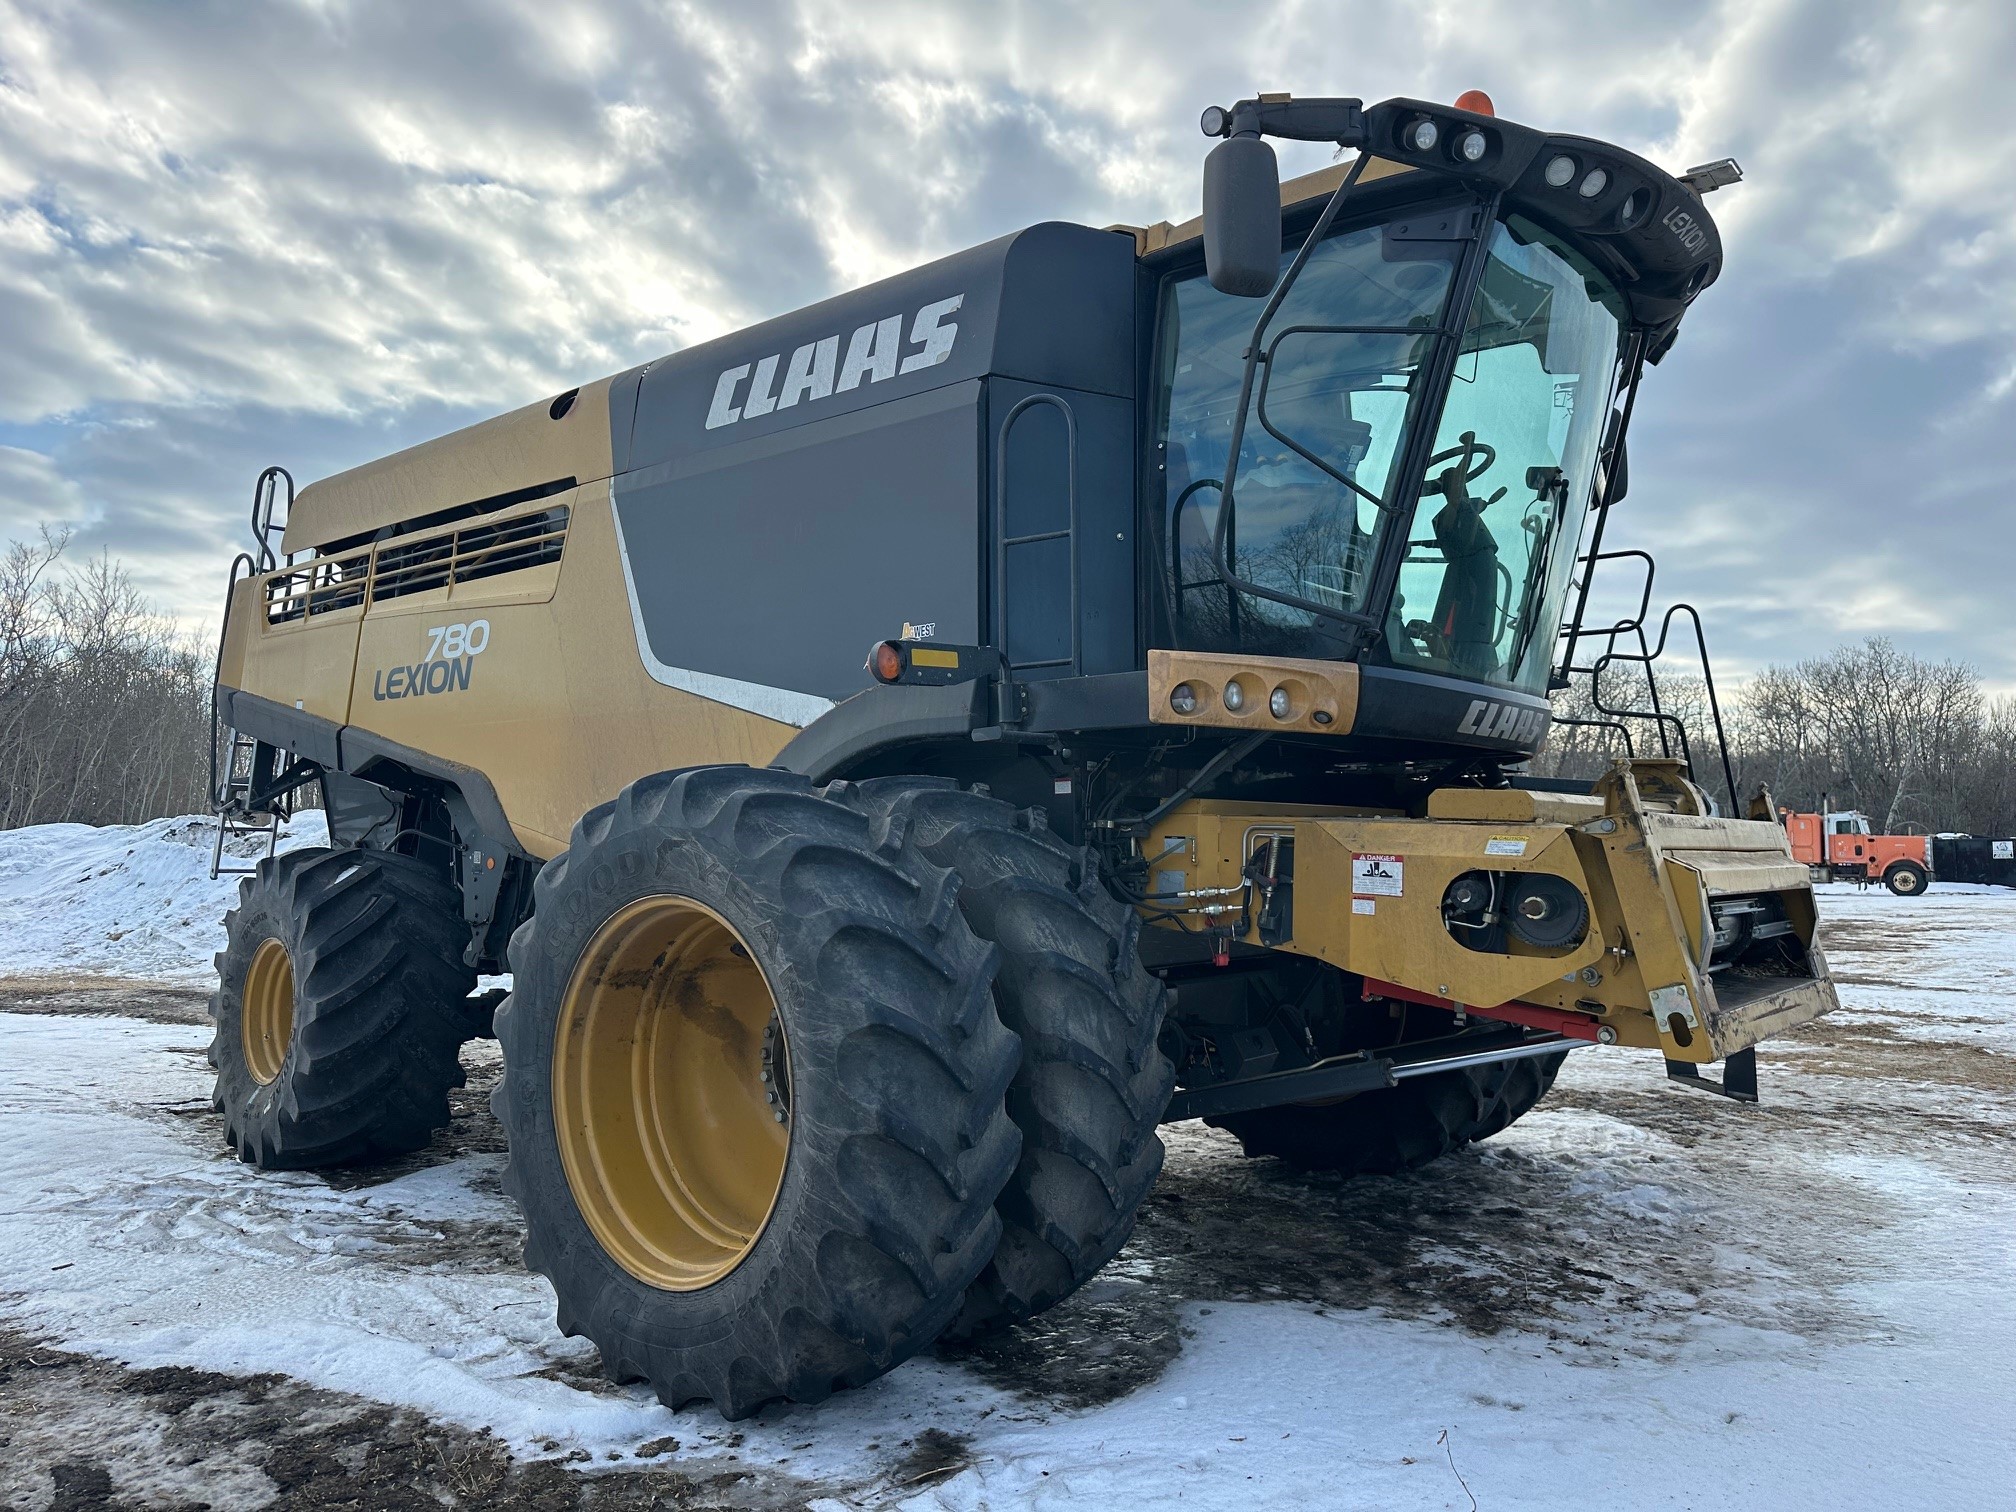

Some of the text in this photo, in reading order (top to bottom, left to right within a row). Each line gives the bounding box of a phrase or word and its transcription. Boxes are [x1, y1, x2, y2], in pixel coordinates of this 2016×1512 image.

[1662, 205, 1709, 257] LEXION
[705, 293, 965, 430] CLAAS
[425, 619, 490, 662] 780
[373, 656, 473, 701] LEXION
[1457, 699, 1544, 743] CLAAS
[1366, 854, 1396, 862] DANGER
